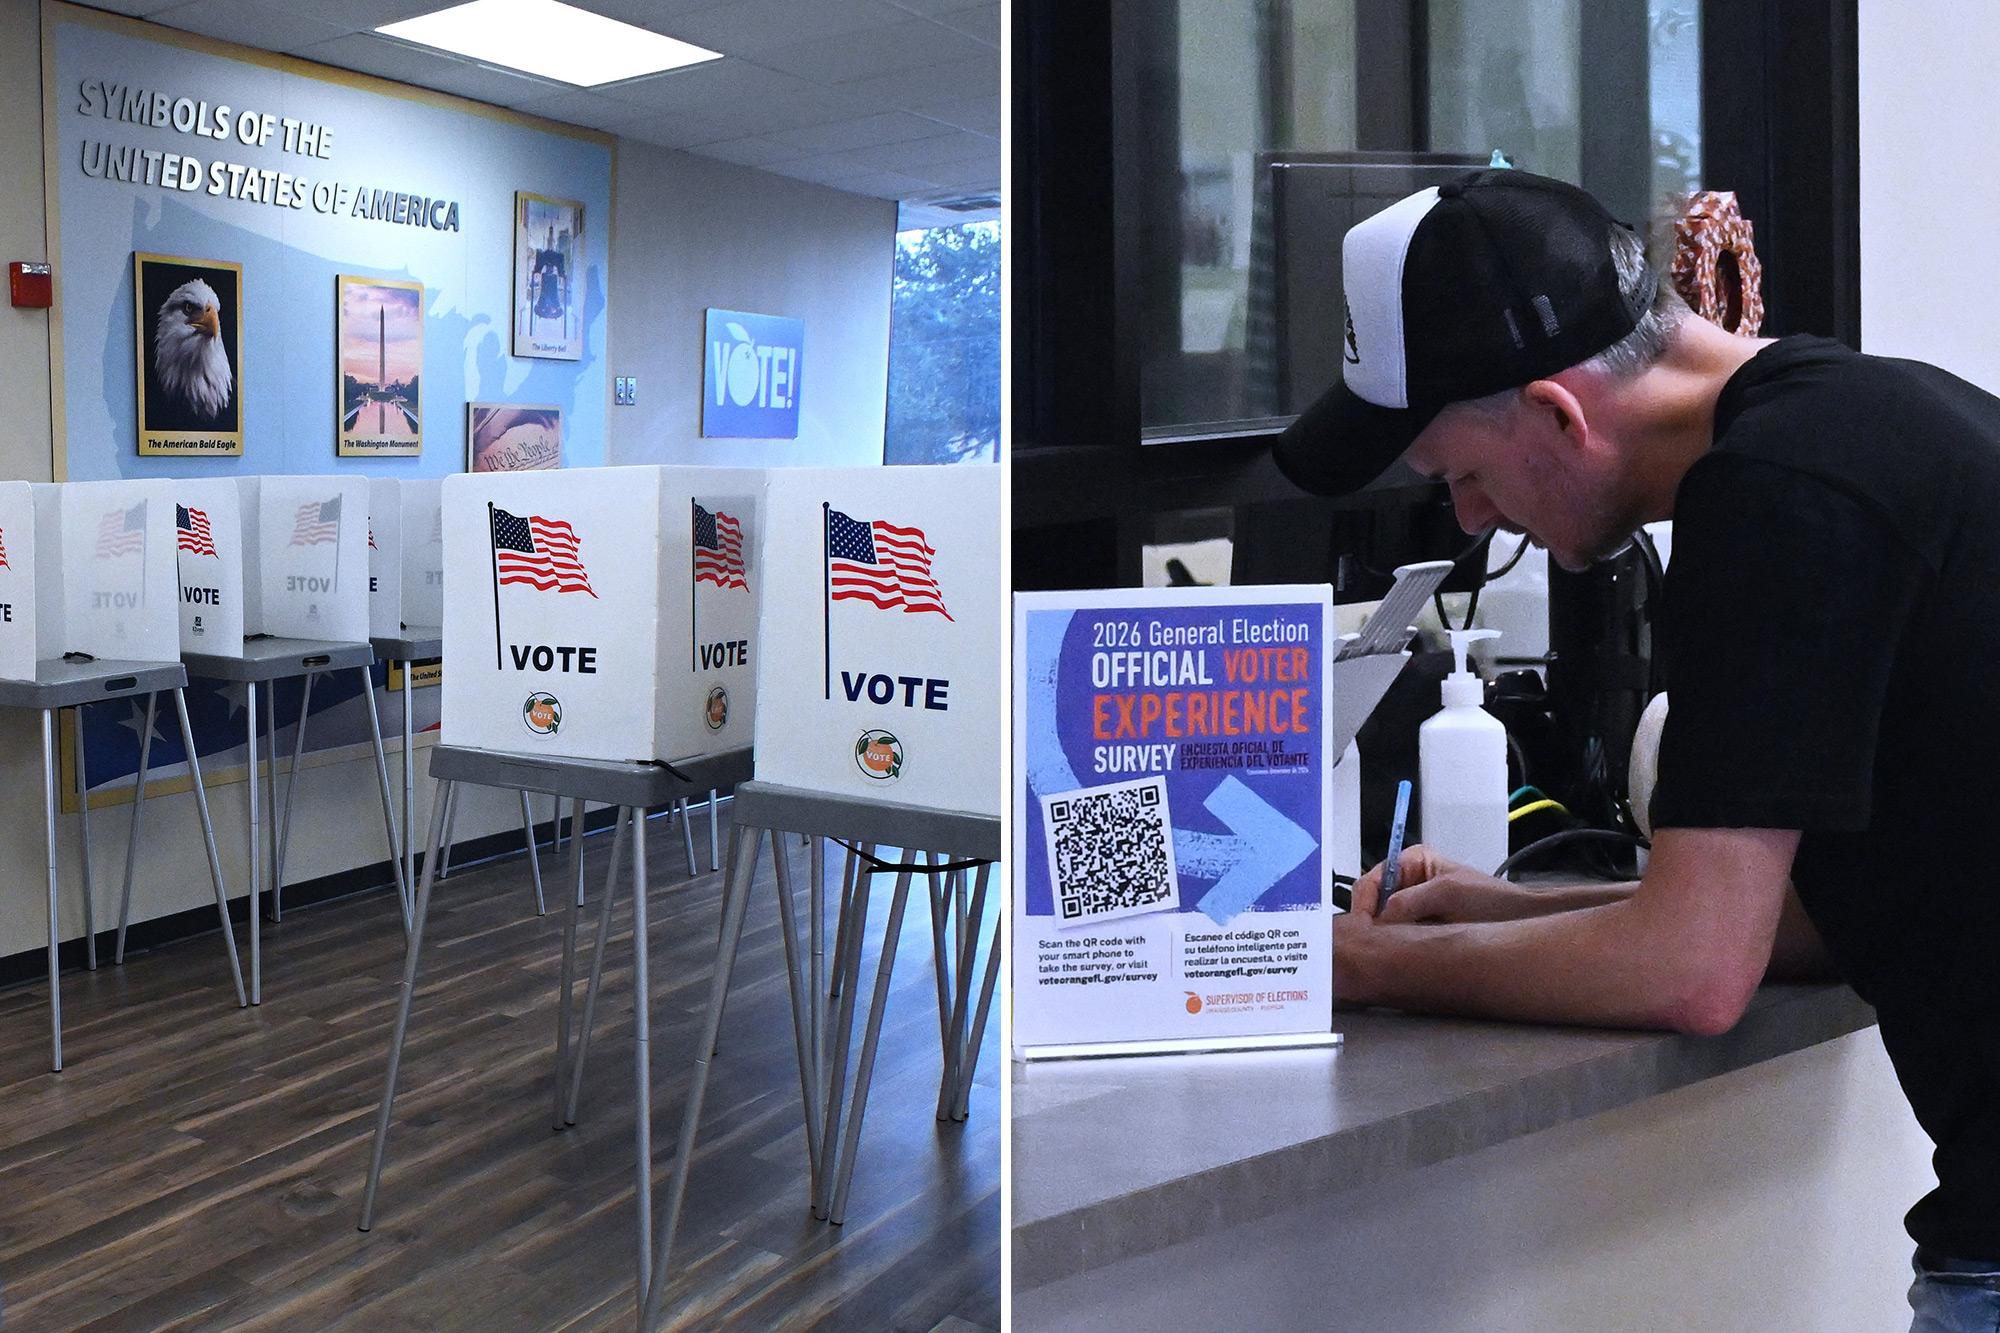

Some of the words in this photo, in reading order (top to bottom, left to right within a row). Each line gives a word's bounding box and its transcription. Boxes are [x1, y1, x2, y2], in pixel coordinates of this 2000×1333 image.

[78, 79, 231, 140] SYMBOLS
[237, 110, 277, 147] OF
[281, 118, 334, 160] THE
[81, 140, 203, 191] UNITED
[207, 160, 308, 210] STATES
[312, 180, 349, 215] OF
[351, 186, 460, 233] AMERICA
[532, 343, 541, 351] The
[542, 343, 557, 352] Liberty
[713, 339, 796, 410] VOTE!
[148, 439, 161, 448] The
[163, 439, 198, 448] American
[200, 439, 215, 448] Bald
[217, 440, 236, 450] Eagle
[344, 440, 354, 448] The
[356, 440, 388, 449] Washington
[390, 440, 418, 448] Monument
[484, 451, 505, 471] We
[517, 434, 550, 460] People
[184, 586, 219, 605] VOTE
[1093, 621, 1141, 647] 2026
[1150, 619, 1225, 646] General
[1233, 618, 1309, 644] Election
[510, 645, 597, 674] VOTE
[701, 640, 747, 671] VOTE
[420, 670, 438, 680] United
[1091, 650, 1213, 688] OFFICIAL
[1223, 647, 1309, 683] VOTER
[840, 671, 949, 711] VOTE
[532, 710, 552, 720] VOTE
[1093, 688, 1310, 740] EXPERIENCE
[866, 750, 891, 762] VOTE
[1181, 742, 1229, 756] ENCUESTA
[1232, 741, 1267, 754] OFICIAL
[1272, 740, 1284, 753] DE
[1094, 744, 1176, 773] SURVEY
[1181, 754, 1243, 770] EXPERIENCIA
[1246, 754, 1265, 768] DEL
[1268, 752, 1309, 767] VOTANTE
[1039, 940, 1063, 949] Scan
[1066, 939, 1080, 948] the
[1083, 938, 1098, 947] QR
[1100, 937, 1122, 946] code
[1125, 936, 1146, 945] with
[1224, 932, 1234, 940] el
[1235, 930, 1266, 941] código
[1267, 929, 1280, 939] QR
[1039, 953, 1060, 962] your
[1063, 951, 1090, 960] smart
[1092, 950, 1122, 960] phone
[1124, 950, 1134, 958] to
[1198, 944, 1235, 954] teléfono
[1236, 943, 1285, 952] inteligente
[1287, 942, 1307, 951] para
[1039, 964, 1060, 973] take
[1062, 963, 1078, 972] the
[1128, 960, 1148, 969] visit
[1184, 956, 1219, 966] realizar
[1220, 956, 1229, 964] la
[1284, 953, 1308, 961] visite
[1206, 993, 1254, 1006] SUPERVISOR
[1256, 992, 1266, 1002] OF
[1268, 990, 1308, 1002] ELECTIONS
